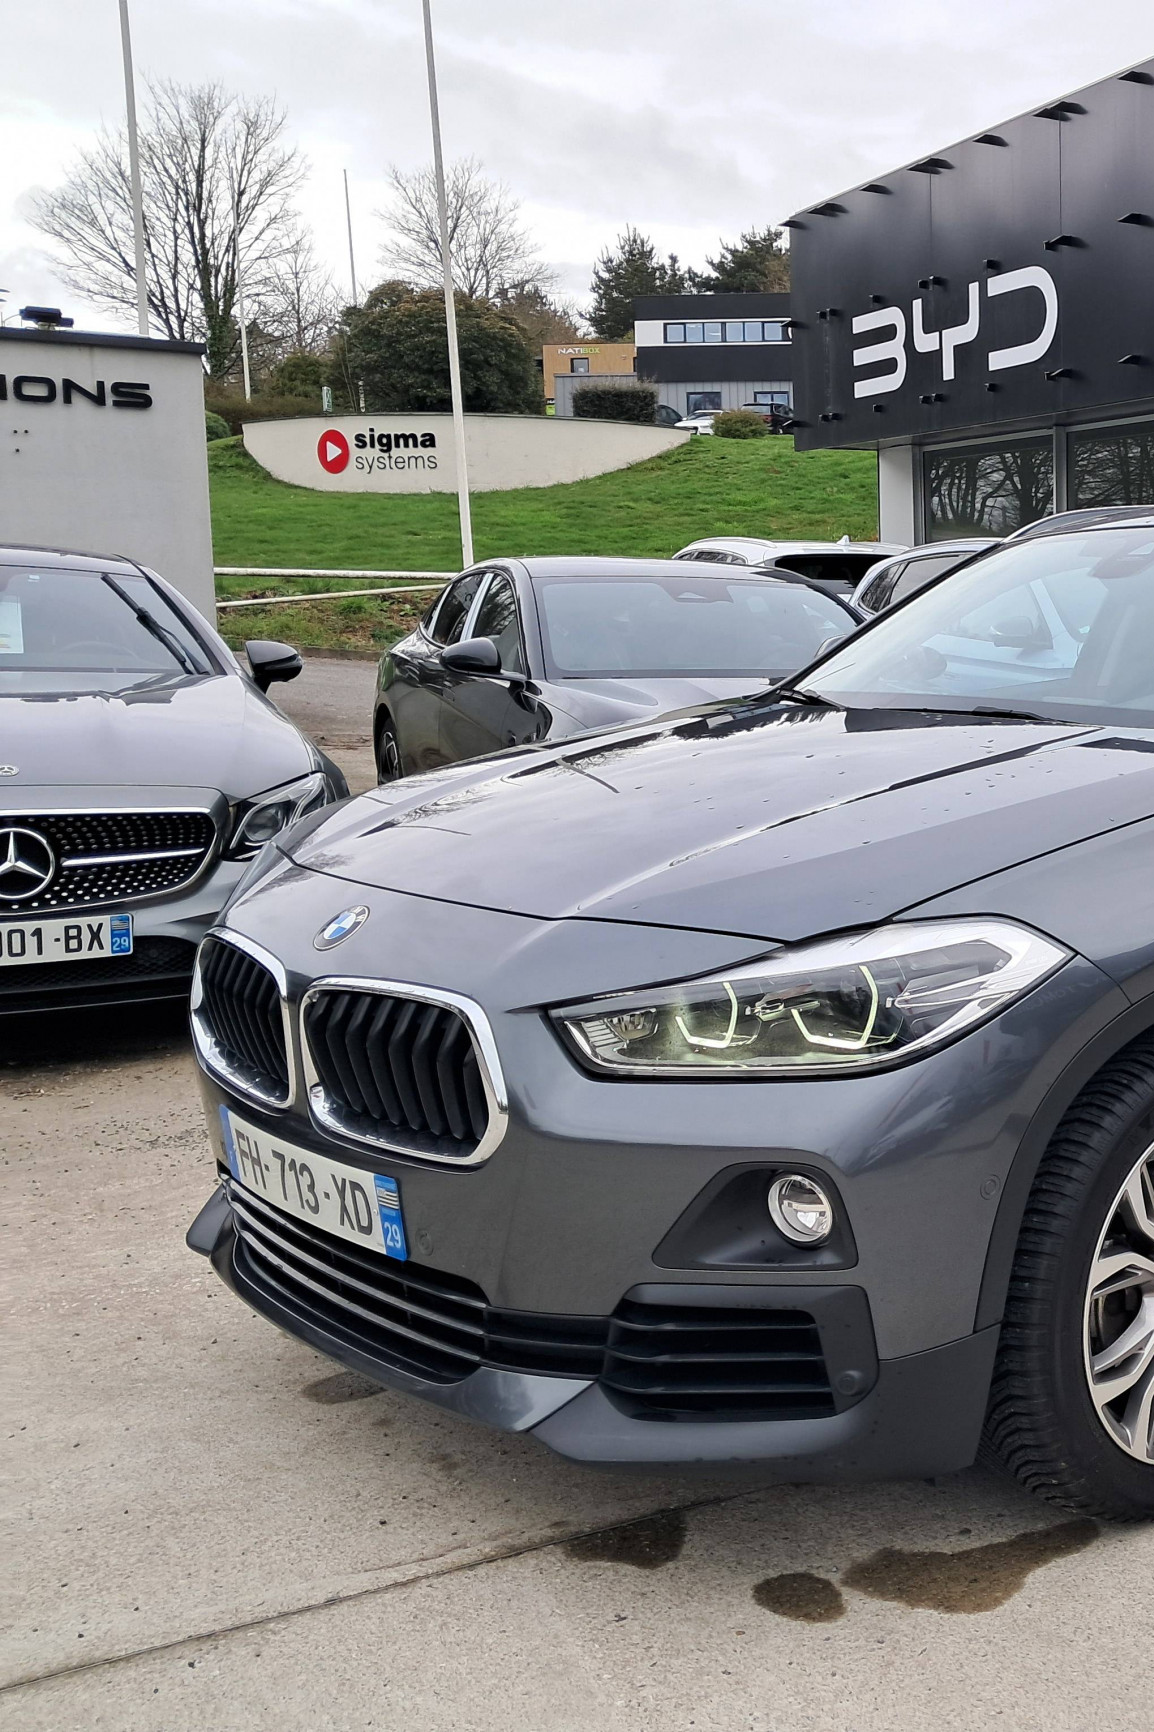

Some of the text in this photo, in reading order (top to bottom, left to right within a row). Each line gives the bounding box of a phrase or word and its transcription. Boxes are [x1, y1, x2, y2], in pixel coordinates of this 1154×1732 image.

[852, 265, 1058, 399] BYD
[354, 428, 436, 453] sigma
[355, 453, 438, 474] systems
[0, 922, 104, 957] 01-BX
[112, 937, 128, 951] 29
[234, 1128, 373, 1236] FH-713-XD
[384, 1222, 401, 1248] 29
